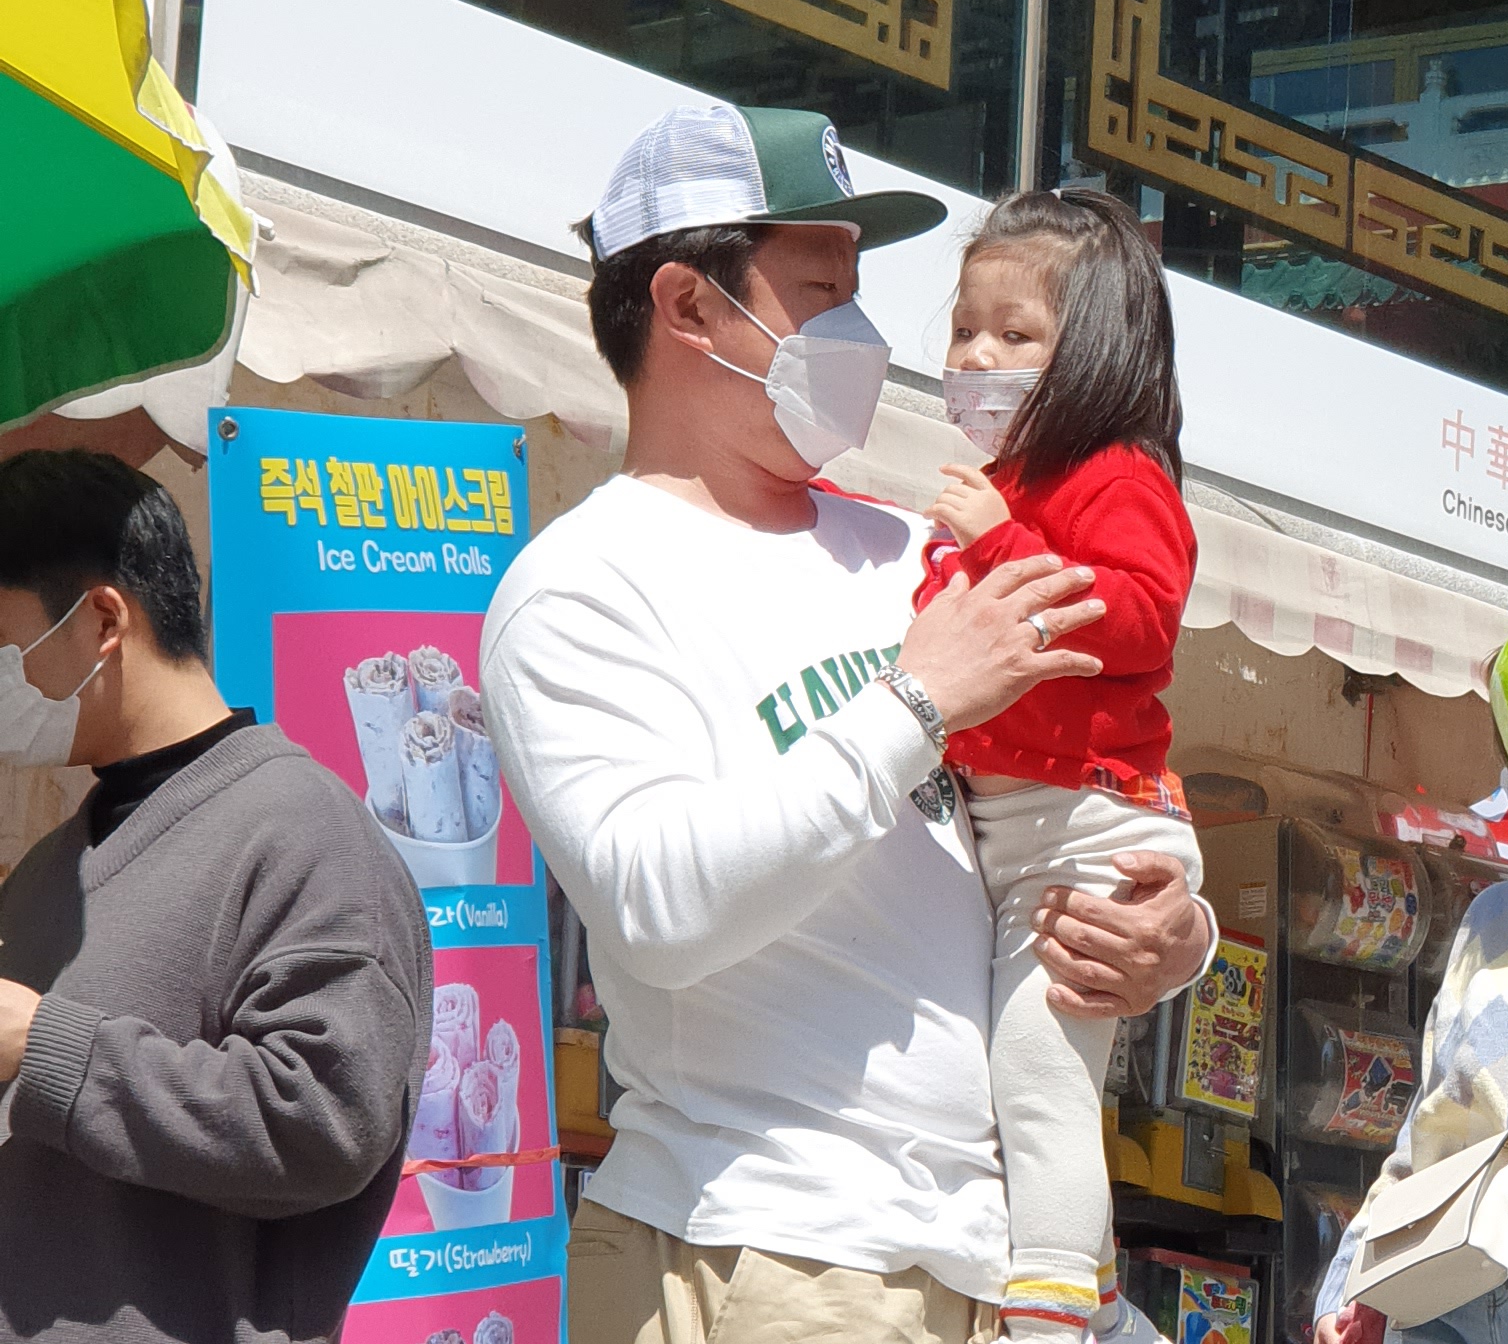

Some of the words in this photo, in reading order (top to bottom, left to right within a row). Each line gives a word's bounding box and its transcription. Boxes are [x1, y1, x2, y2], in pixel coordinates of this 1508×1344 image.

[260, 457, 327, 527] 즉석
[325, 456, 388, 529] 철판
[386, 463, 515, 536] 아이스크림
[317, 539, 357, 572] Ice
[362, 539, 438, 574] Cream
[441, 543, 493, 576] Rolls
